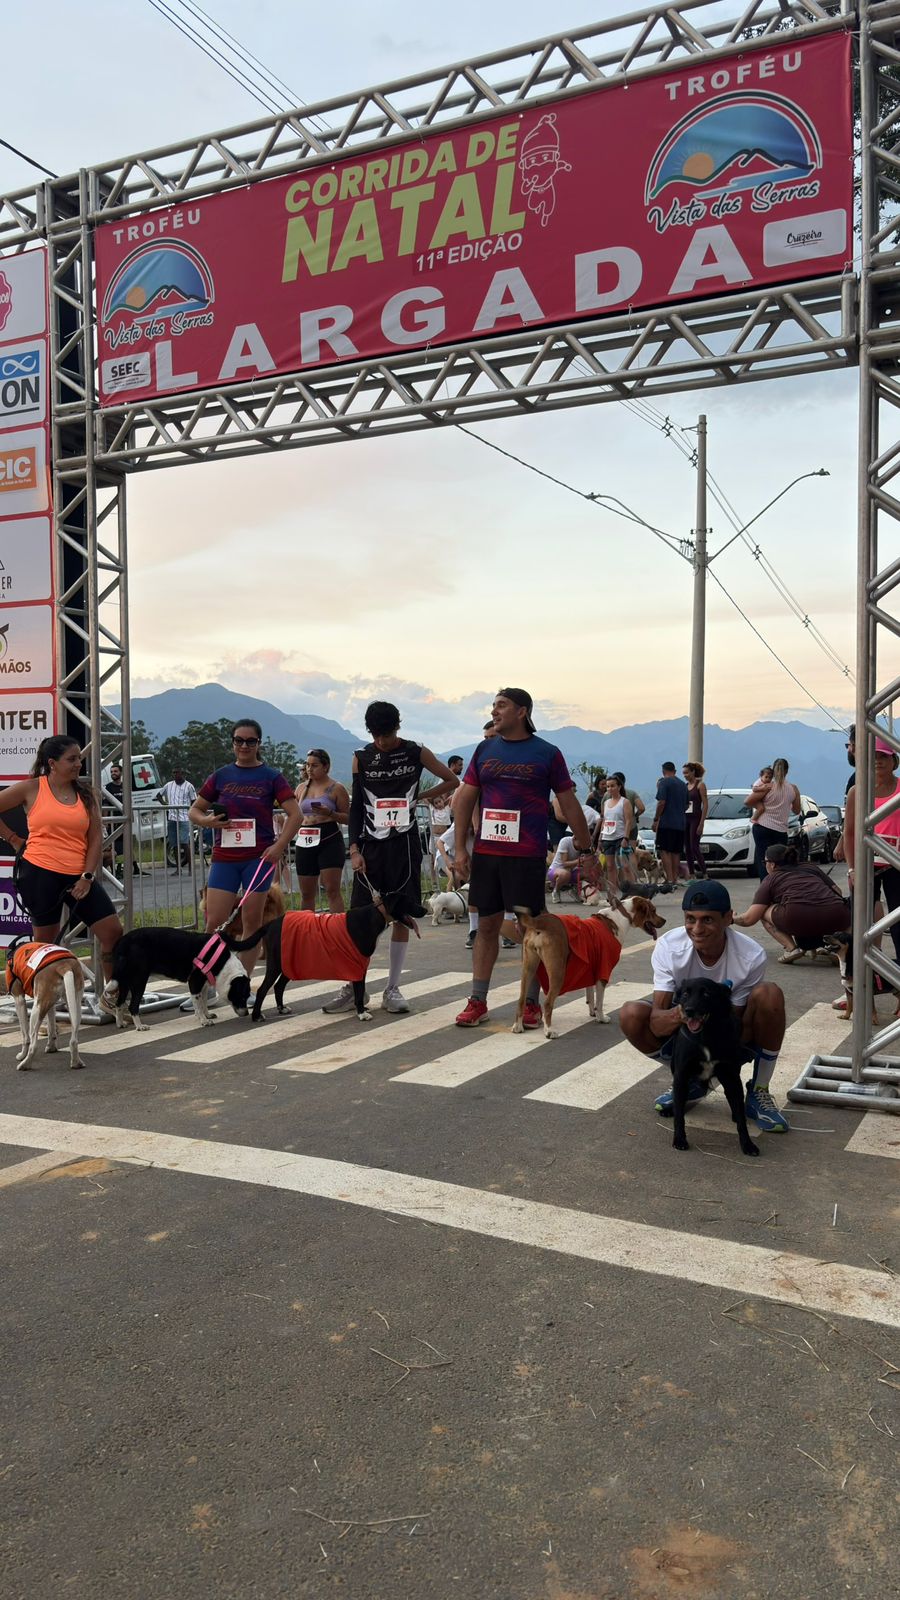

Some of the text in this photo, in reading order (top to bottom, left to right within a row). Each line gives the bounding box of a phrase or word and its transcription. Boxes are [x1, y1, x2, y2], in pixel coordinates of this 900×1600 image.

[664, 50, 803, 100] TROFÉU
[285, 121, 521, 213] CORRIDA DE
[281, 161, 526, 283] NATAL
[648, 180, 820, 234] Vista das Serras
[112, 208, 200, 245] TROFÉU
[786, 229, 823, 246] Cruzeiro
[416, 232, 523, 272] 11ª EDIÇÃO
[155, 223, 754, 393] LARGADA
[104, 310, 214, 350] Vista das Serras
[110, 360, 141, 379] SEEC
[1, 375, 40, 409] ON
[365, 765, 416, 778] cervélo
[386, 810, 399, 821] 17
[494, 823, 507, 835] 18
[235, 831, 242, 842] 9
[304, 836, 313, 845] 16
